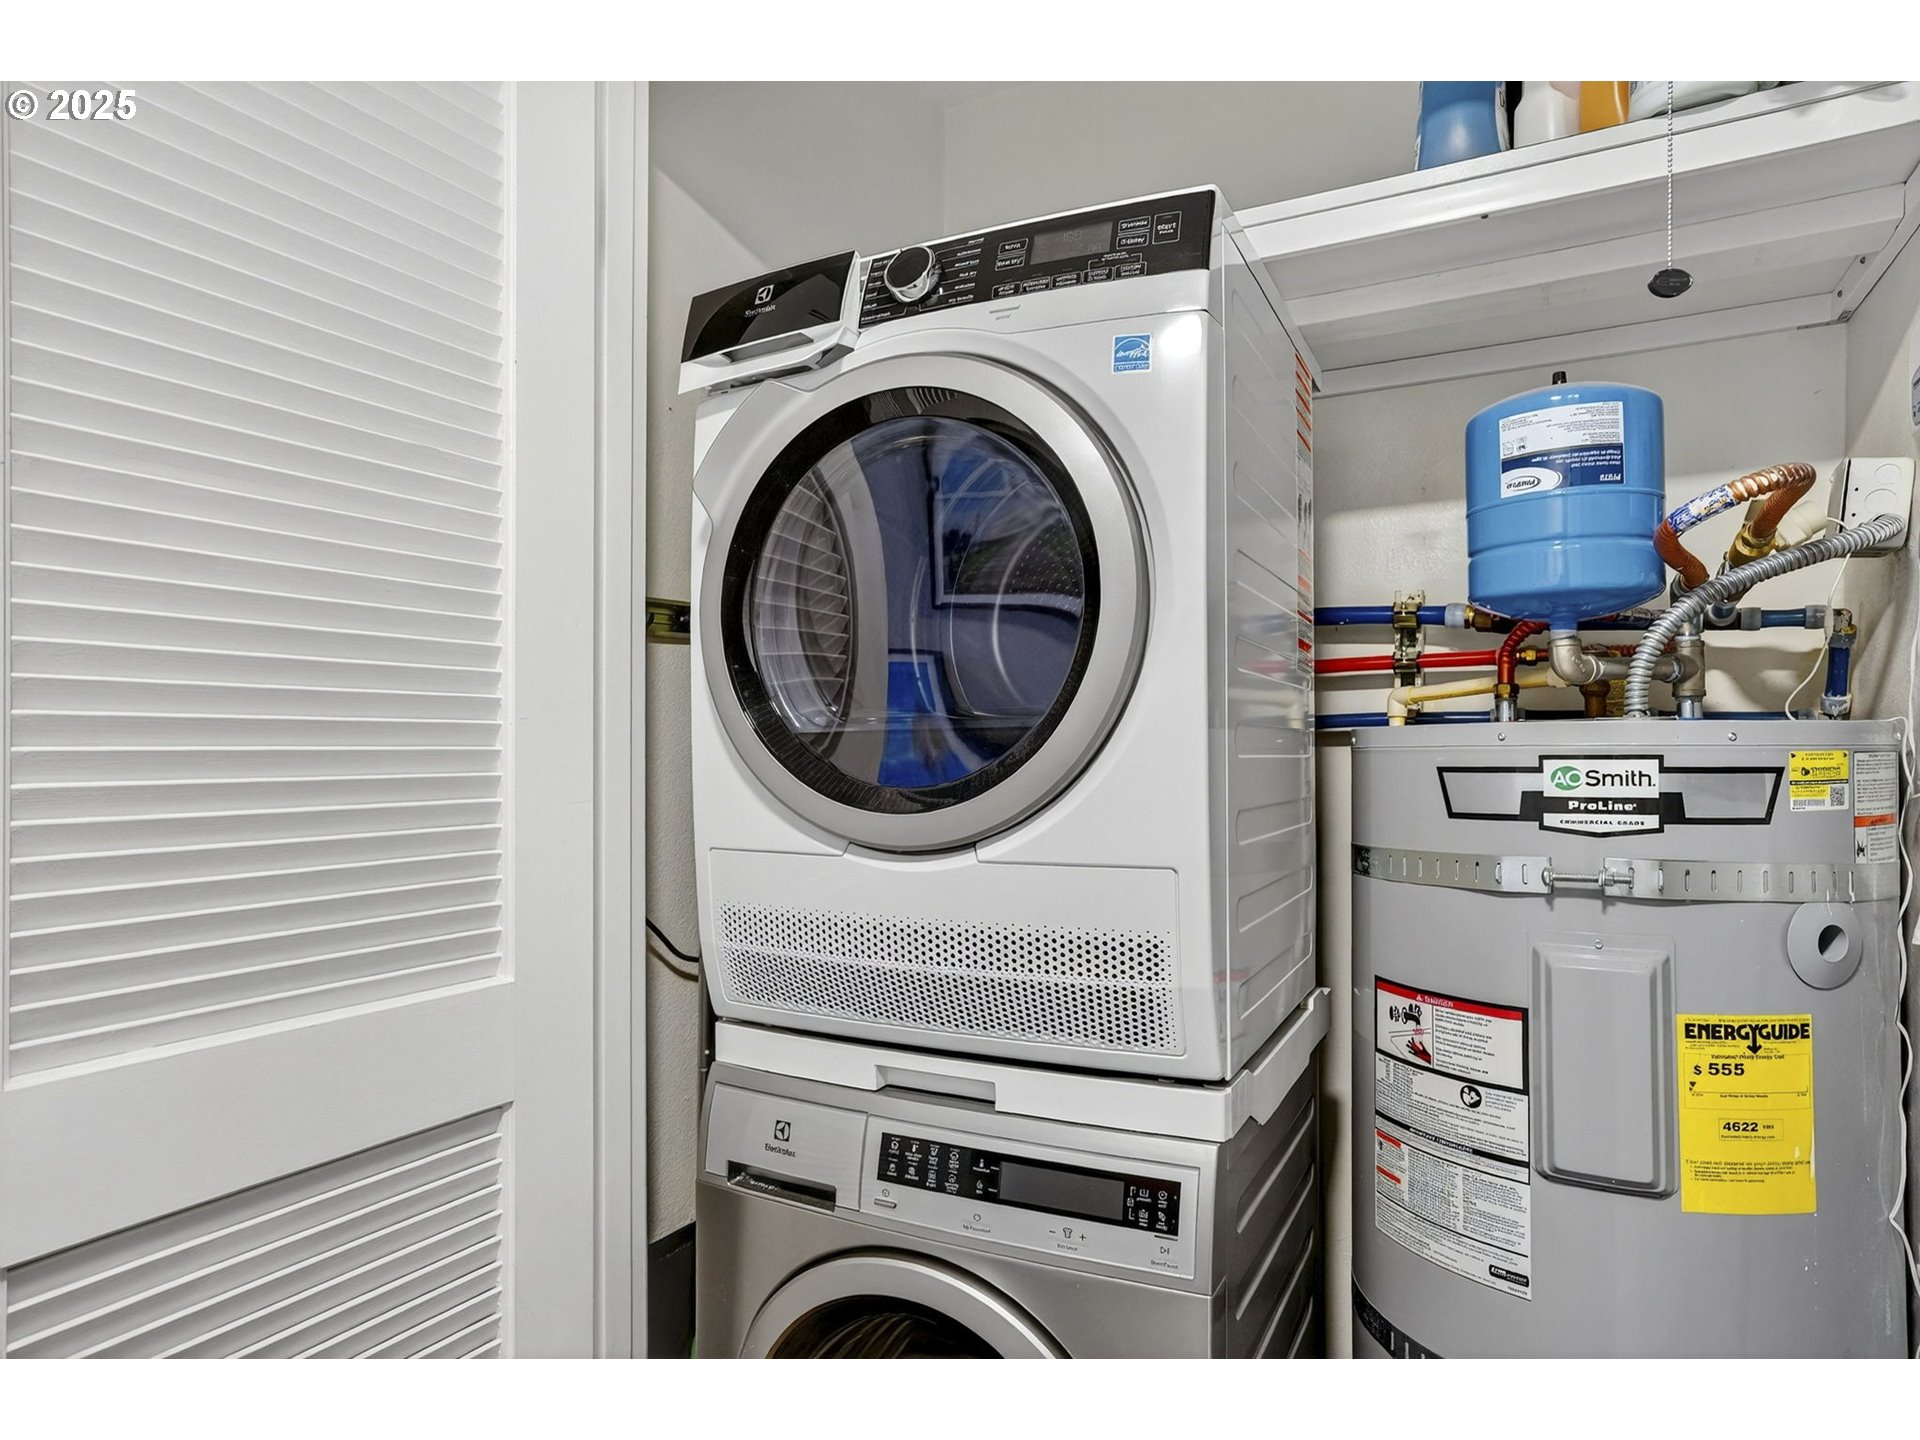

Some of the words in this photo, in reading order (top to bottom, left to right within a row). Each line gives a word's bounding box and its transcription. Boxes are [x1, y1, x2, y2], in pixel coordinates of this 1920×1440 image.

[1684, 1022, 1811, 1043] ENERGYGUIDE
[1693, 1064, 1703, 1076] $
[1708, 1062, 1745, 1076] 555
[1723, 1121, 1759, 1132] 4622
